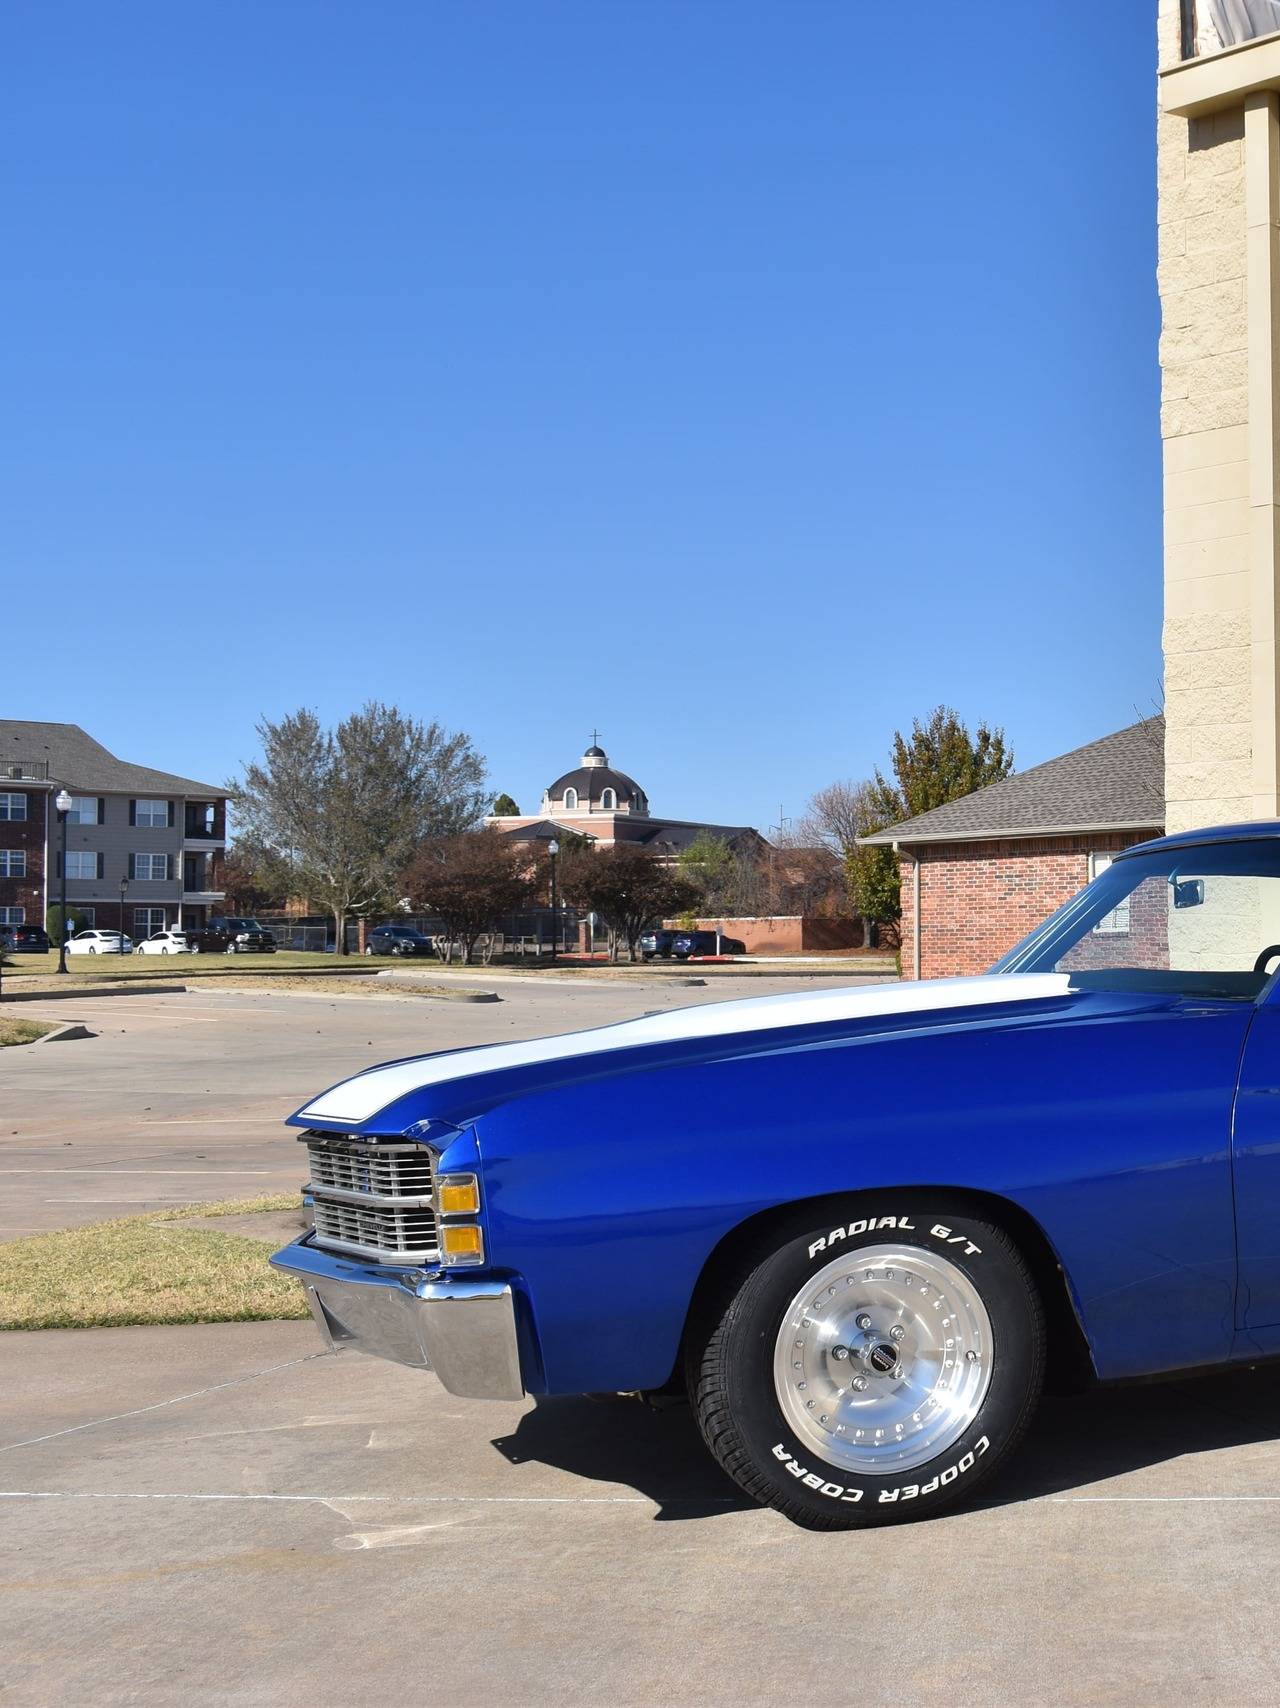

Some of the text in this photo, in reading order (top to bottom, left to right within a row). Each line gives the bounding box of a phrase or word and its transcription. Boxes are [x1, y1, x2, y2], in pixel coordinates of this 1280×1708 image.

[808, 1216, 983, 1259] RADIAL G/T
[771, 1435, 990, 1504] COOPER COBRA
